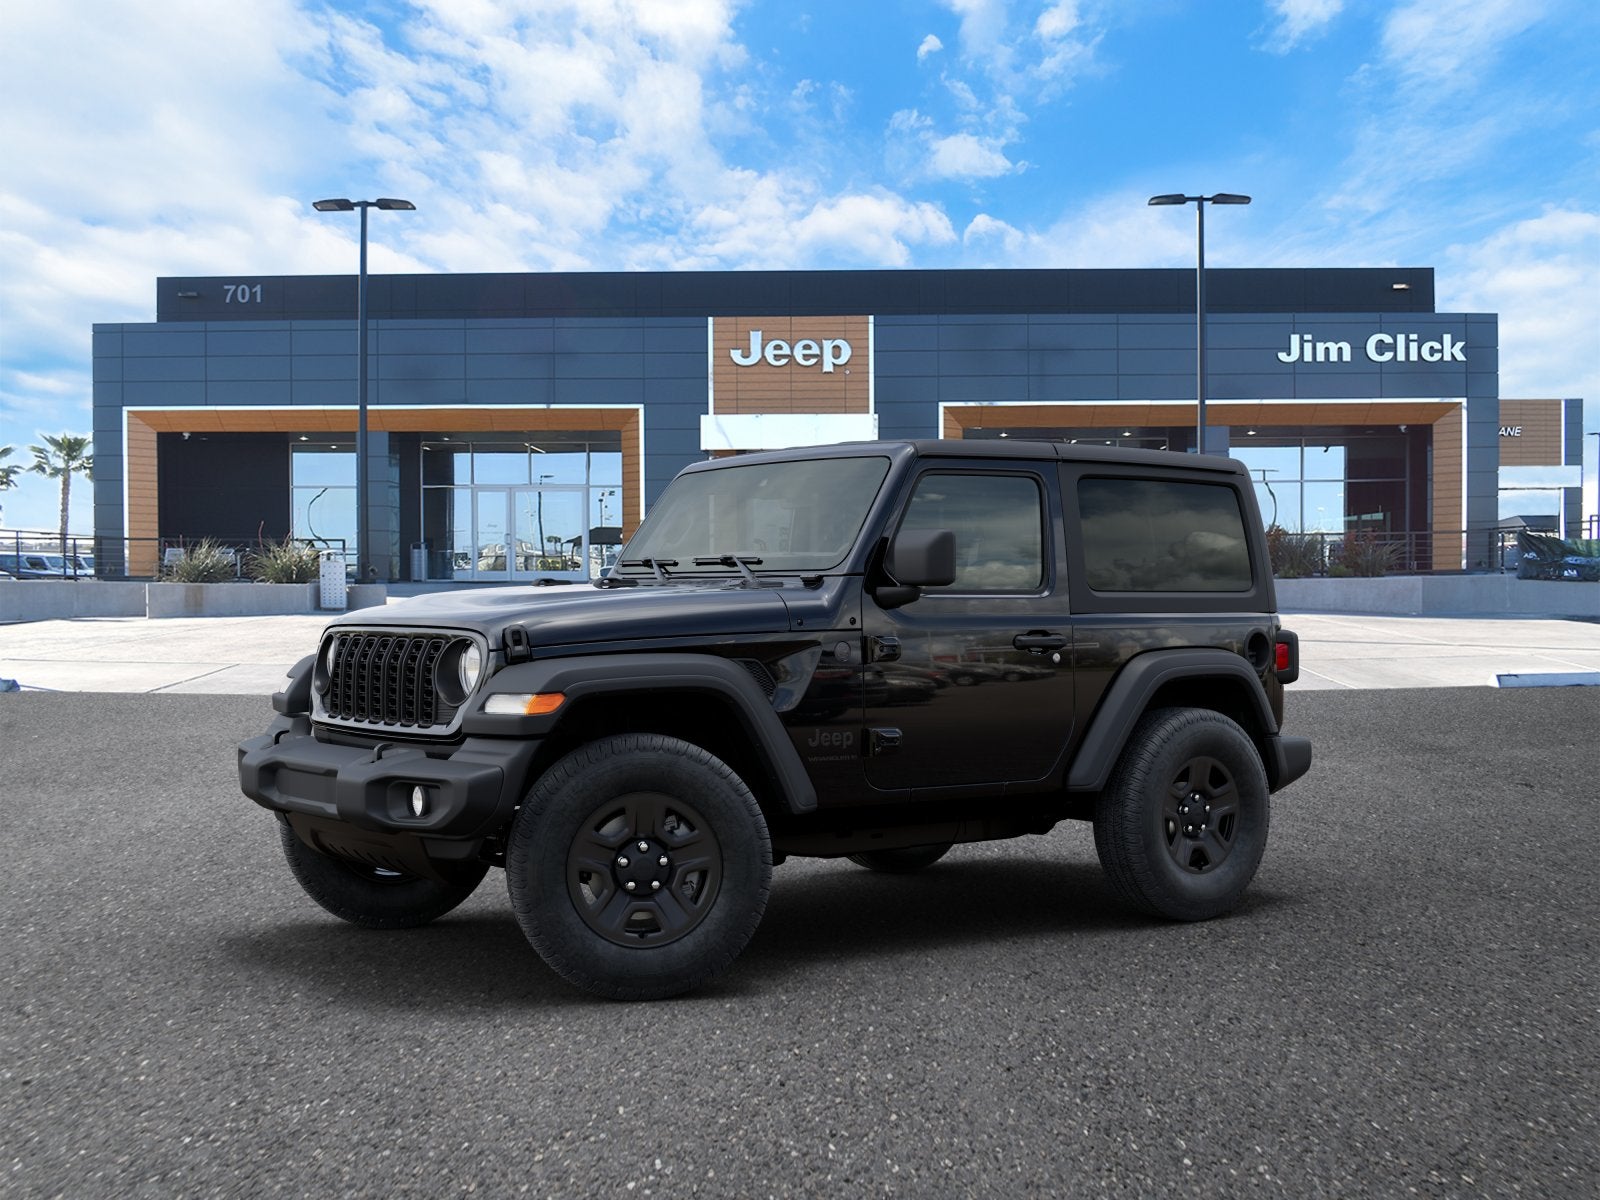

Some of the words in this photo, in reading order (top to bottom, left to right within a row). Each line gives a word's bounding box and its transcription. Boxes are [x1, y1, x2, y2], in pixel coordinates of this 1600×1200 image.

[223, 284, 263, 303] 701
[729, 330, 852, 374] Jeep
[1277, 333, 1352, 363] Jim
[1365, 333, 1467, 363] Click
[807, 728, 854, 749] Jeep
